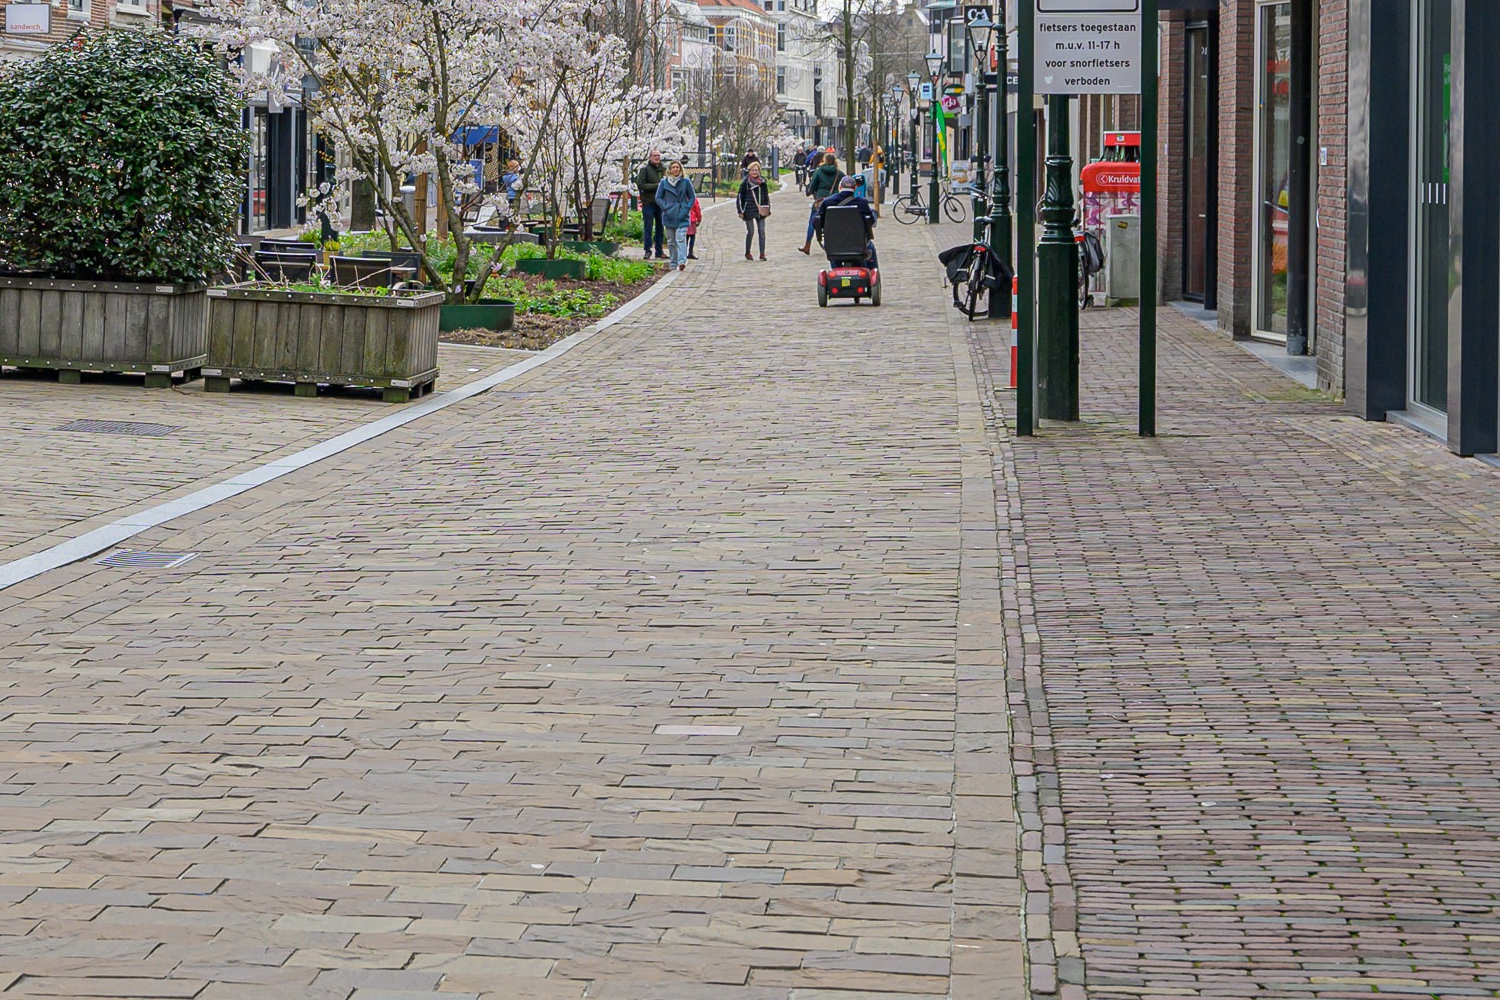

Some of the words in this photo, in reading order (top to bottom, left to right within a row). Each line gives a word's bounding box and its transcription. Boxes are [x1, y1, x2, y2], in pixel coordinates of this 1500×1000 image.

[1039, 23, 1078, 32] fietsers
[1081, 23, 1136, 34] toegestaan
[1055, 41, 1085, 50] m.u.v.
[1088, 41, 1111, 50] 11-17
[1113, 41, 1120, 50] h
[1070, 58, 1130, 67] snorfietsers
[1064, 77, 1111, 85] verboden
